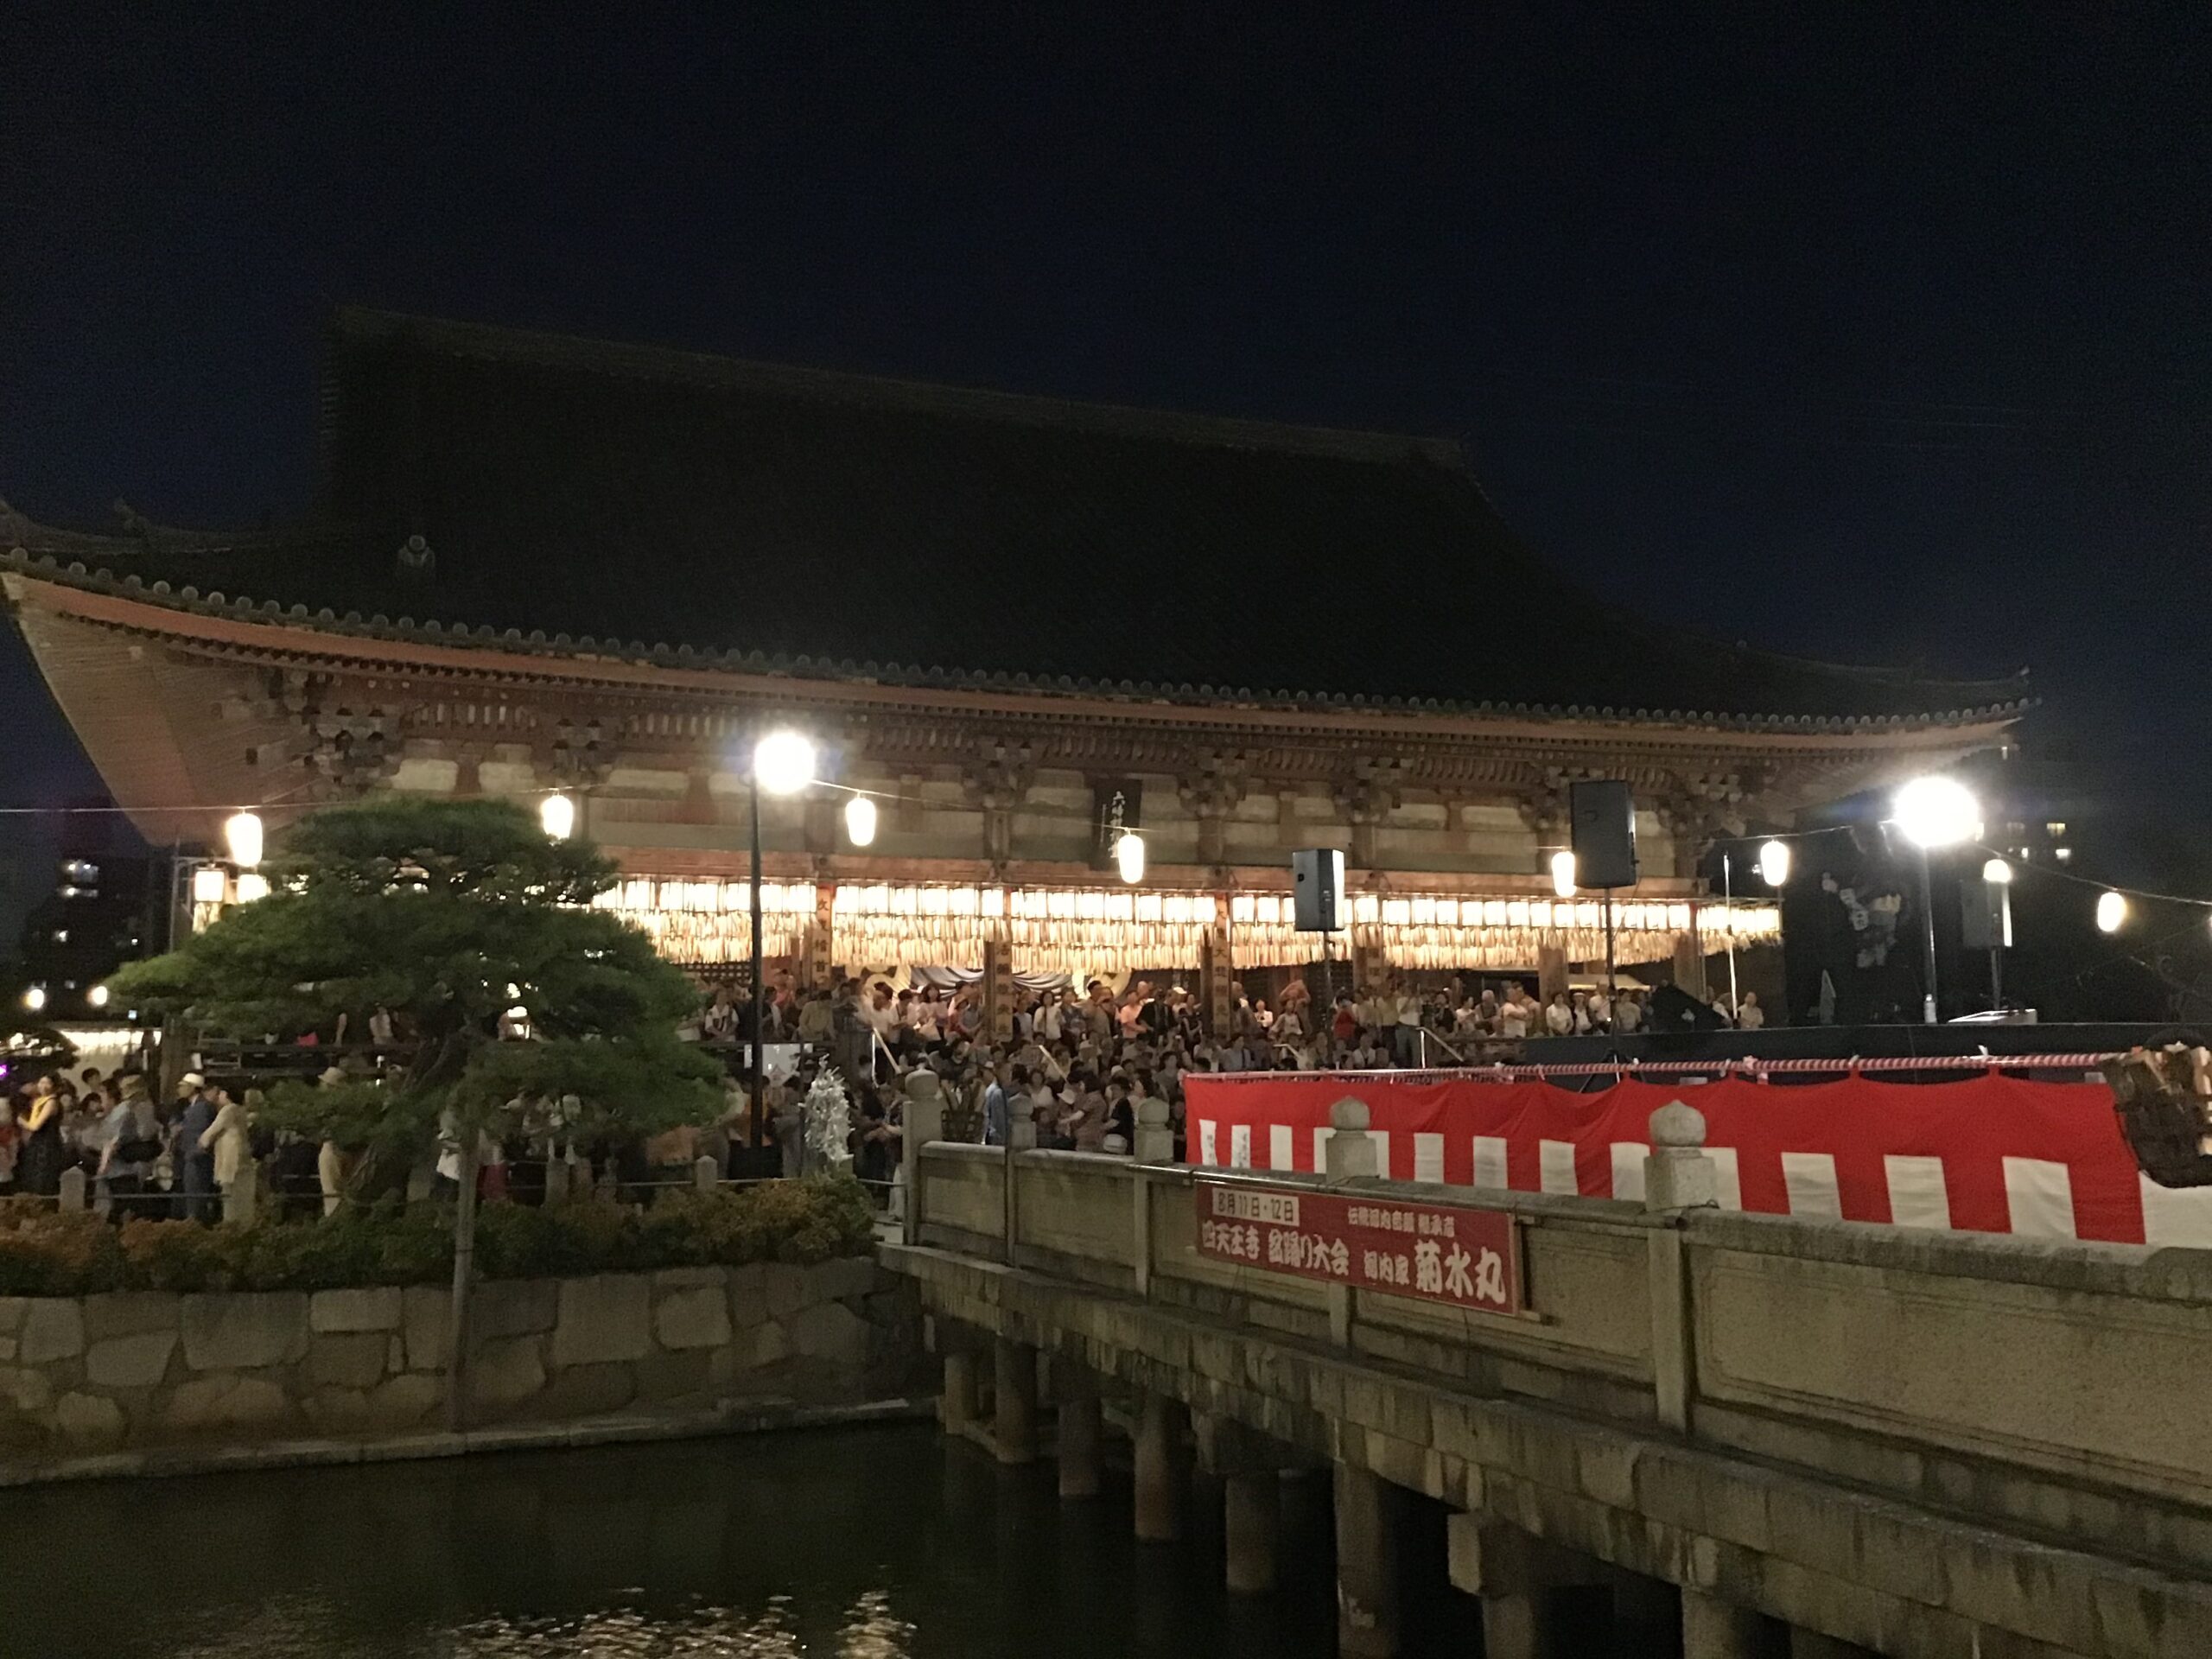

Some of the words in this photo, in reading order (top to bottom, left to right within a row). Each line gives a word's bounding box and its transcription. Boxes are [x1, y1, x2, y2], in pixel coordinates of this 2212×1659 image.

[1202, 1219, 1260, 1260] 四天王寺
[1268, 1228, 1349, 1276] 盆踊り大会
[1363, 1249, 1410, 1285] 河内家
[1414, 1239, 1507, 1304] 菊水丸
